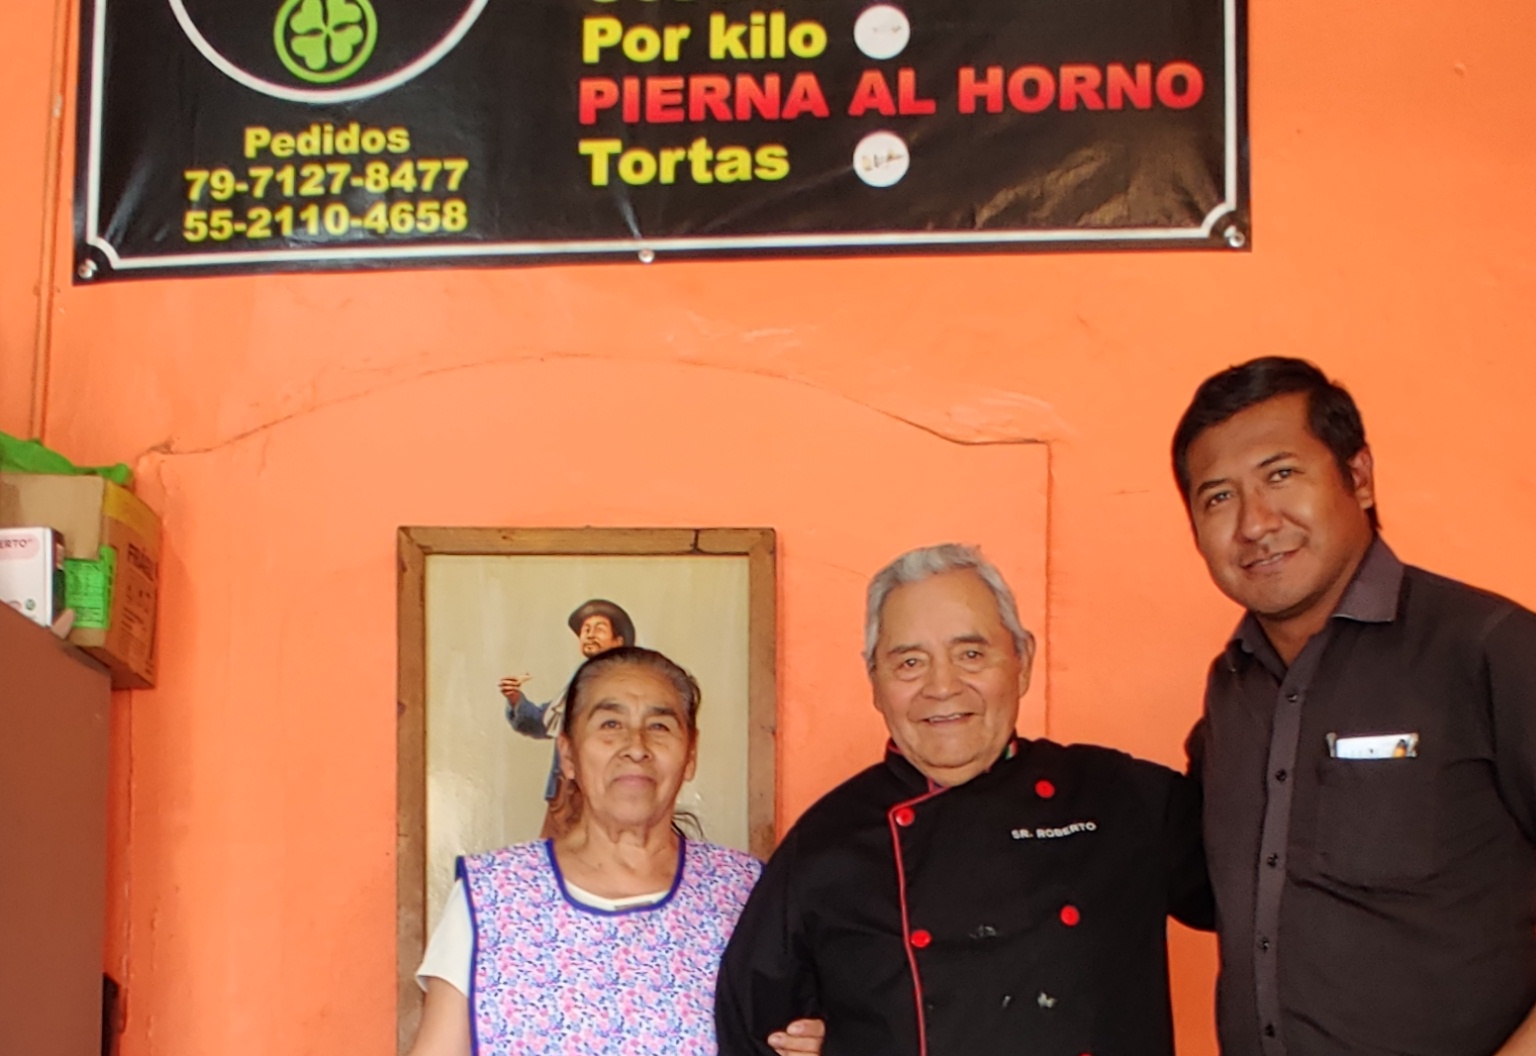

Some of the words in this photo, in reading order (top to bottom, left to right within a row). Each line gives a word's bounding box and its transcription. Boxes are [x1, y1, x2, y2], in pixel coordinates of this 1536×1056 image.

[581, 15, 691, 64] Por
[708, 10, 828, 60] kilo
[578, 71, 830, 126] PIERNA
[847, 67, 937, 117] AL
[957, 59, 1205, 114] HORNO
[243, 122, 411, 159] Pedidos
[577, 136, 791, 186] Tortas
[183, 157, 470, 202] 79-7127-8477
[182, 198, 469, 242] 55-2110-4658
[1010, 828, 1034, 840] SR.
[1035, 820, 1098, 839] ROBERTO
